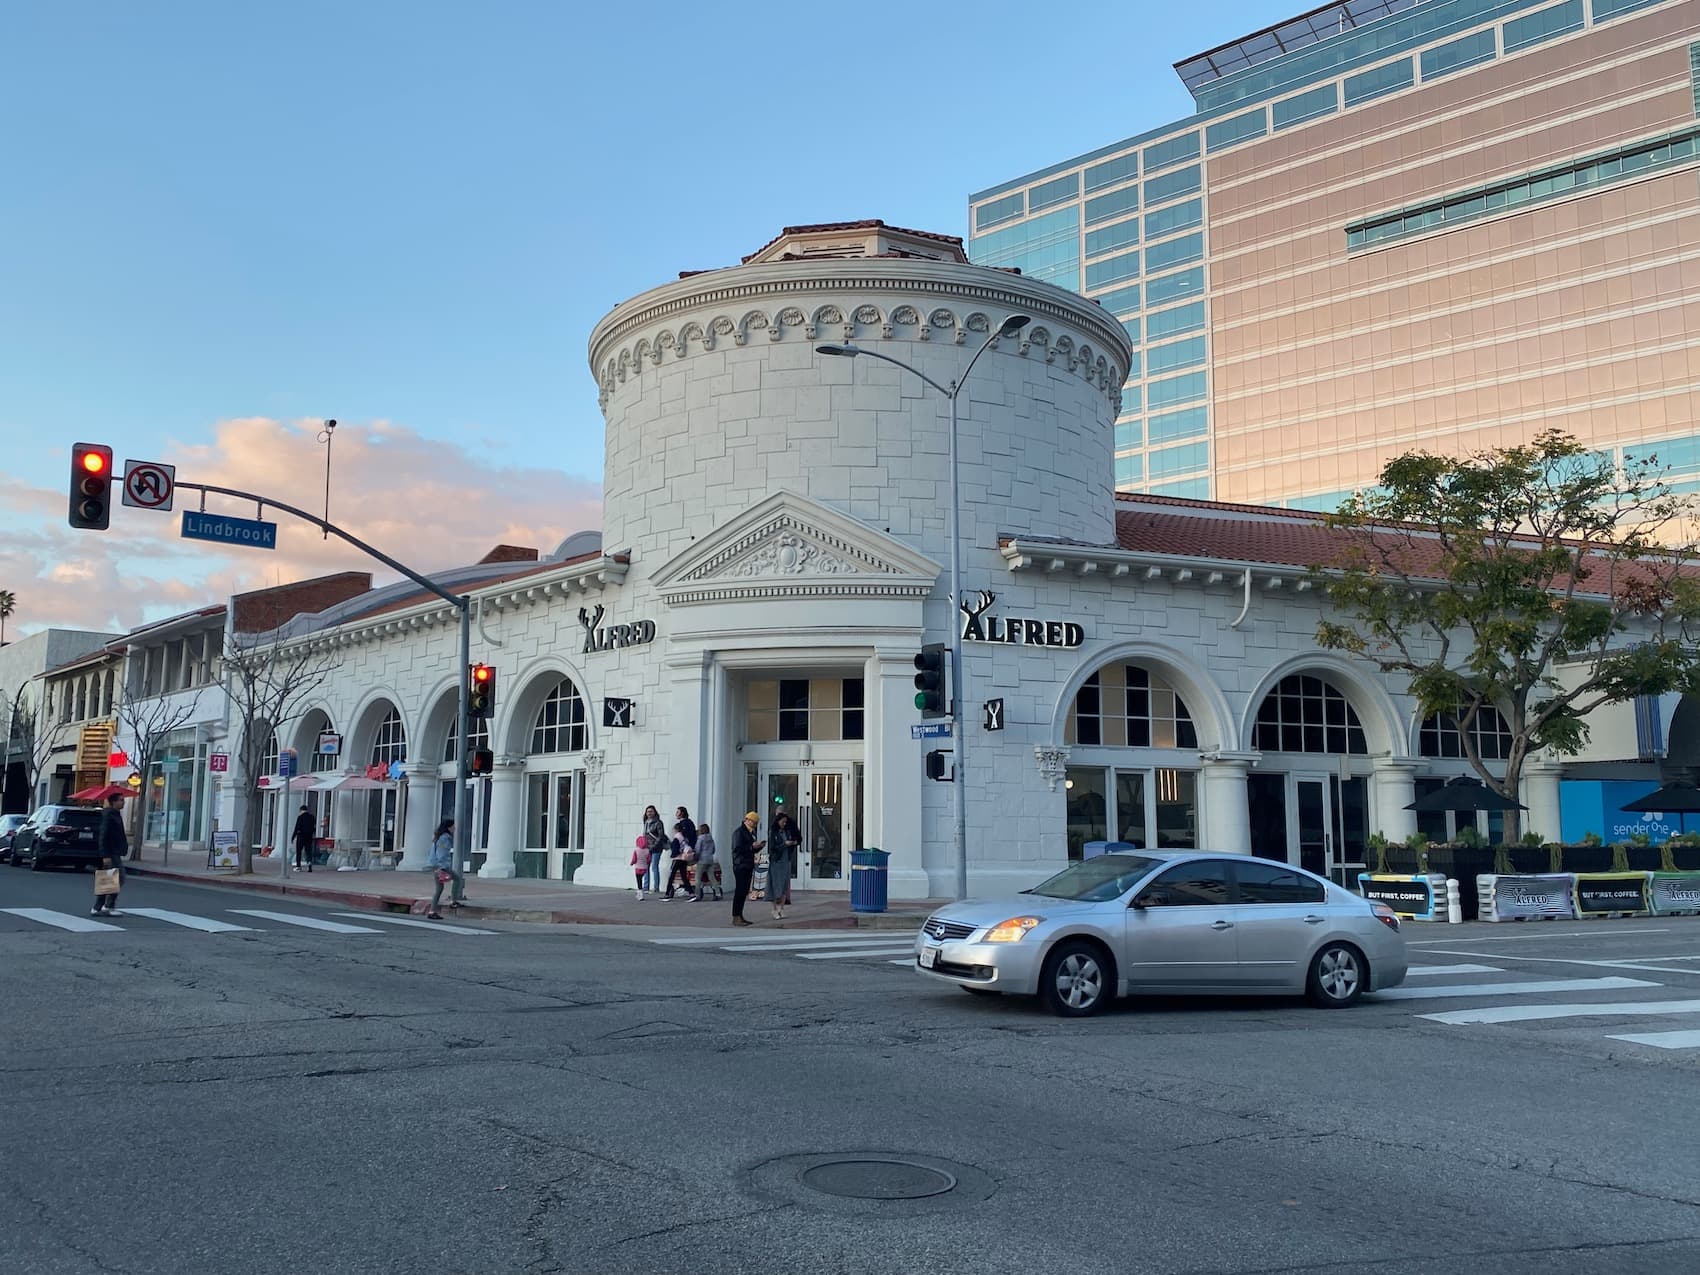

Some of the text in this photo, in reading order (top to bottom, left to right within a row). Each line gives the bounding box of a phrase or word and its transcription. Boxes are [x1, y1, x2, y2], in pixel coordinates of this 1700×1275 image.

[186, 518, 271, 542] Lindbrook
[579, 606, 656, 653] ALFRED
[955, 592, 1084, 646] ALFRED
